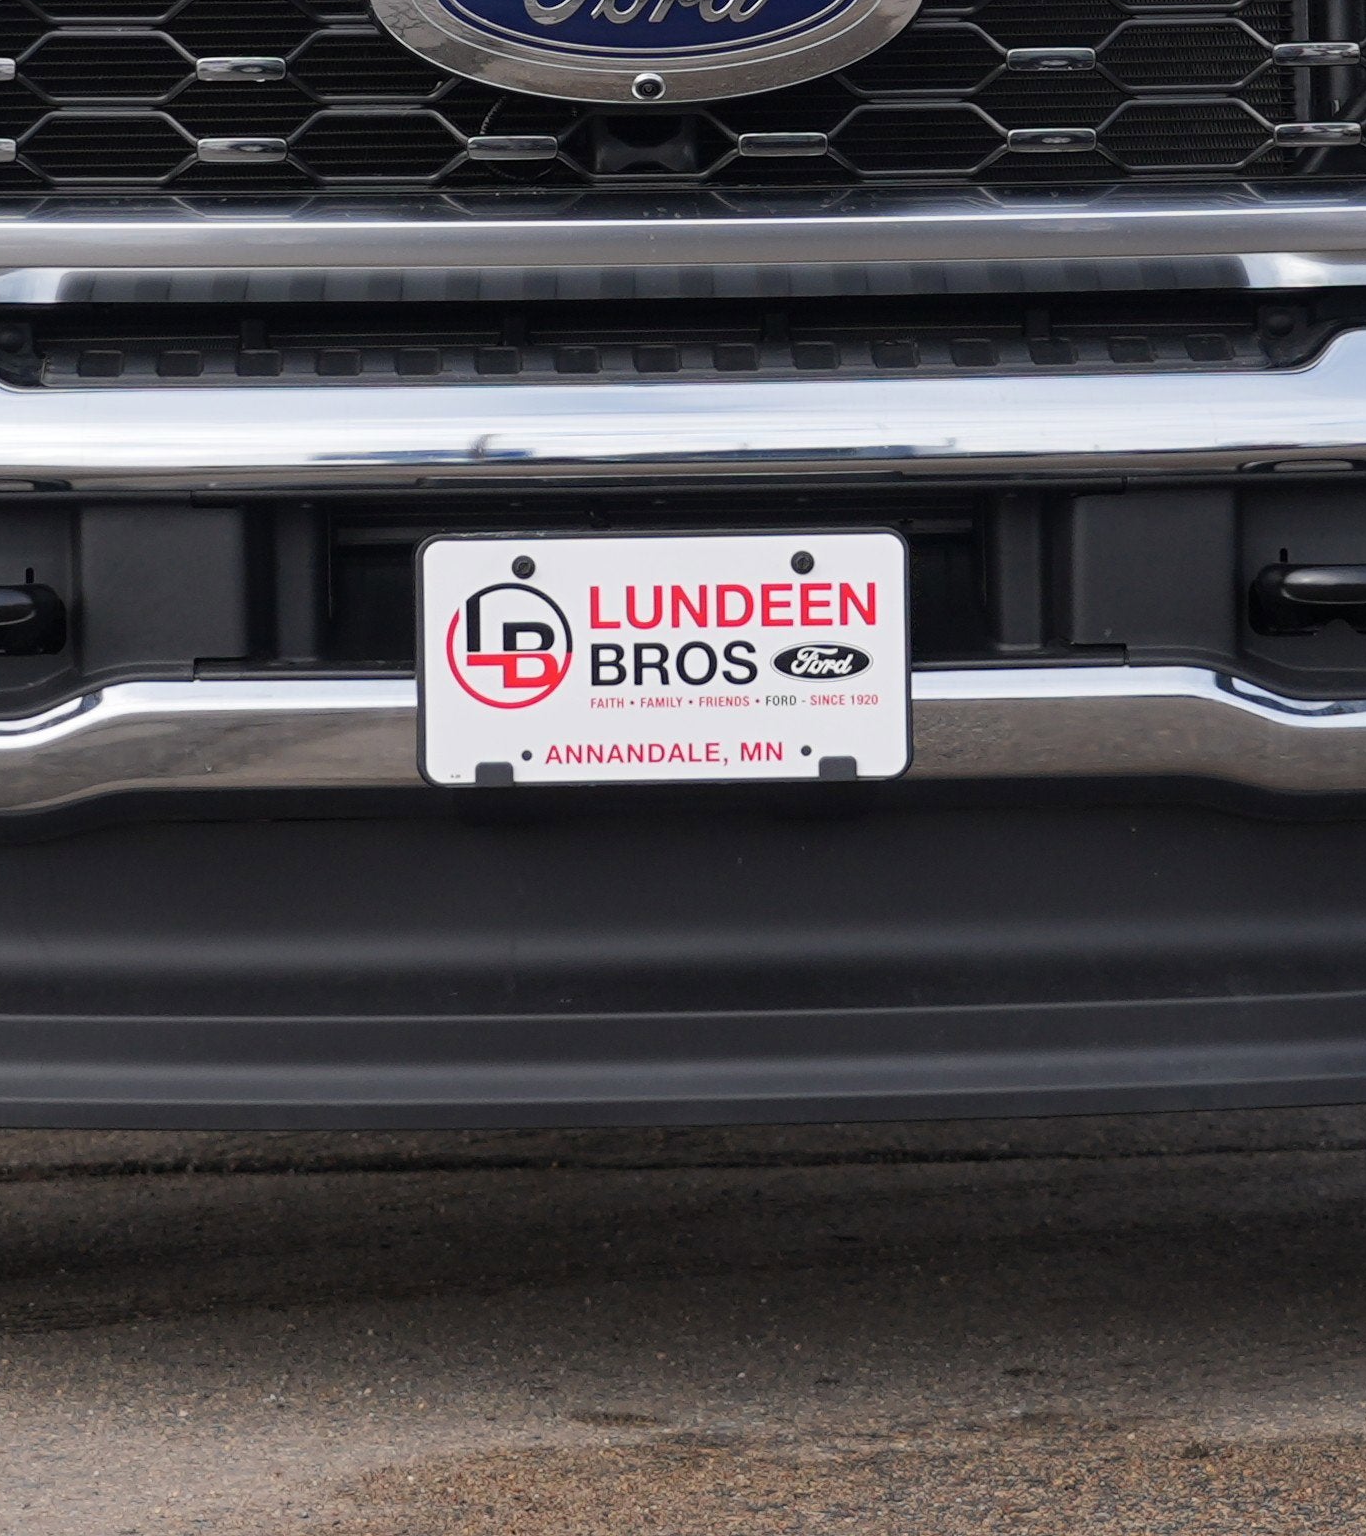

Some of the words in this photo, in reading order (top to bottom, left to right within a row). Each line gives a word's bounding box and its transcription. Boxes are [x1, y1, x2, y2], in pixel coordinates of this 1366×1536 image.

[589, 582, 877, 630] LUNDEEN
[590, 639, 758, 687] BROS
[790, 645, 854, 676] Ford
[589, 697, 625, 709] FAITH
[639, 696, 684, 708] FAMILY
[698, 695, 750, 707] FRIENDS
[765, 694, 797, 706] FORD
[809, 694, 846, 706] SINCE
[850, 693, 879, 706] 1920
[545, 741, 729, 766] ANNANDALE,
[739, 741, 784, 762] MN
